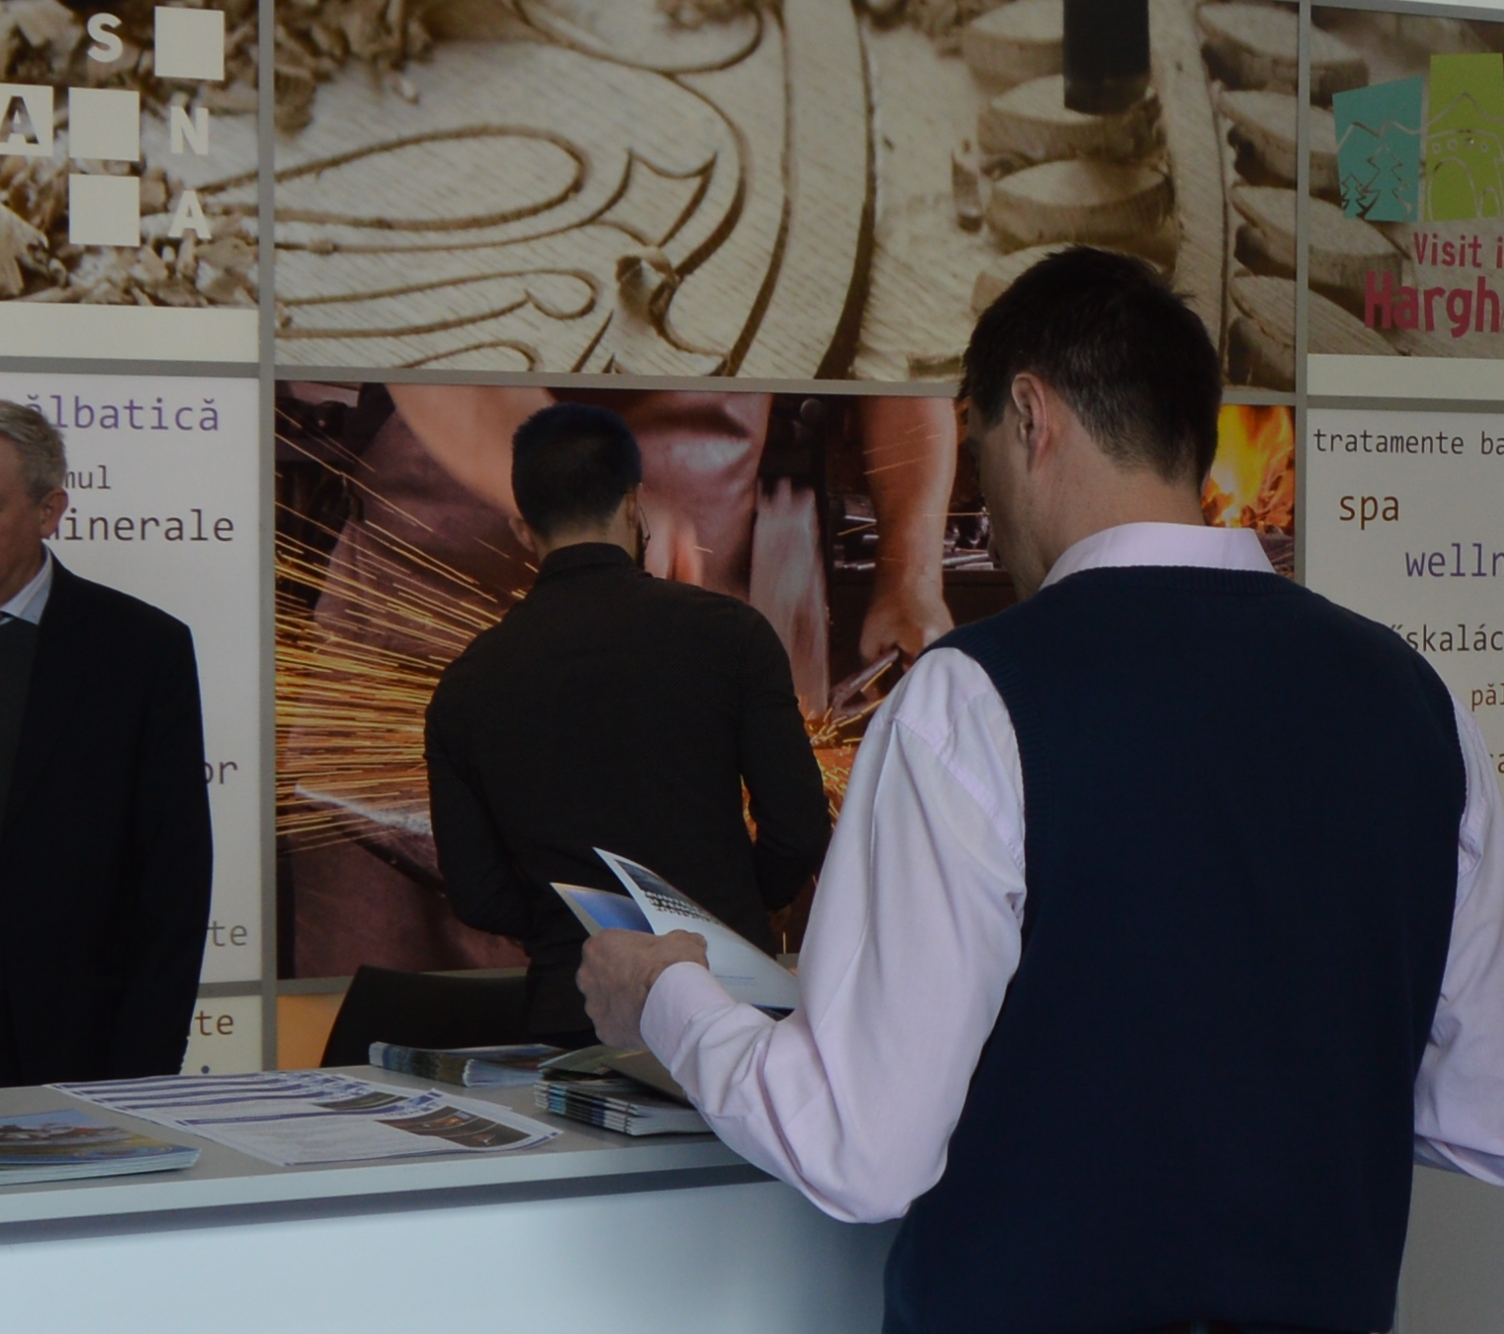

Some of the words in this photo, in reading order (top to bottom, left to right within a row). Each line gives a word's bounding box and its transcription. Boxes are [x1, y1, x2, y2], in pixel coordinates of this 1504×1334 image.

[1413, 232, 1486, 269] Visit
[25, 394, 219, 432] ălbatică
[1312, 428, 1465, 455] tratamente
[45, 508, 235, 542] inerale
[1338, 493, 1400, 530] spa
